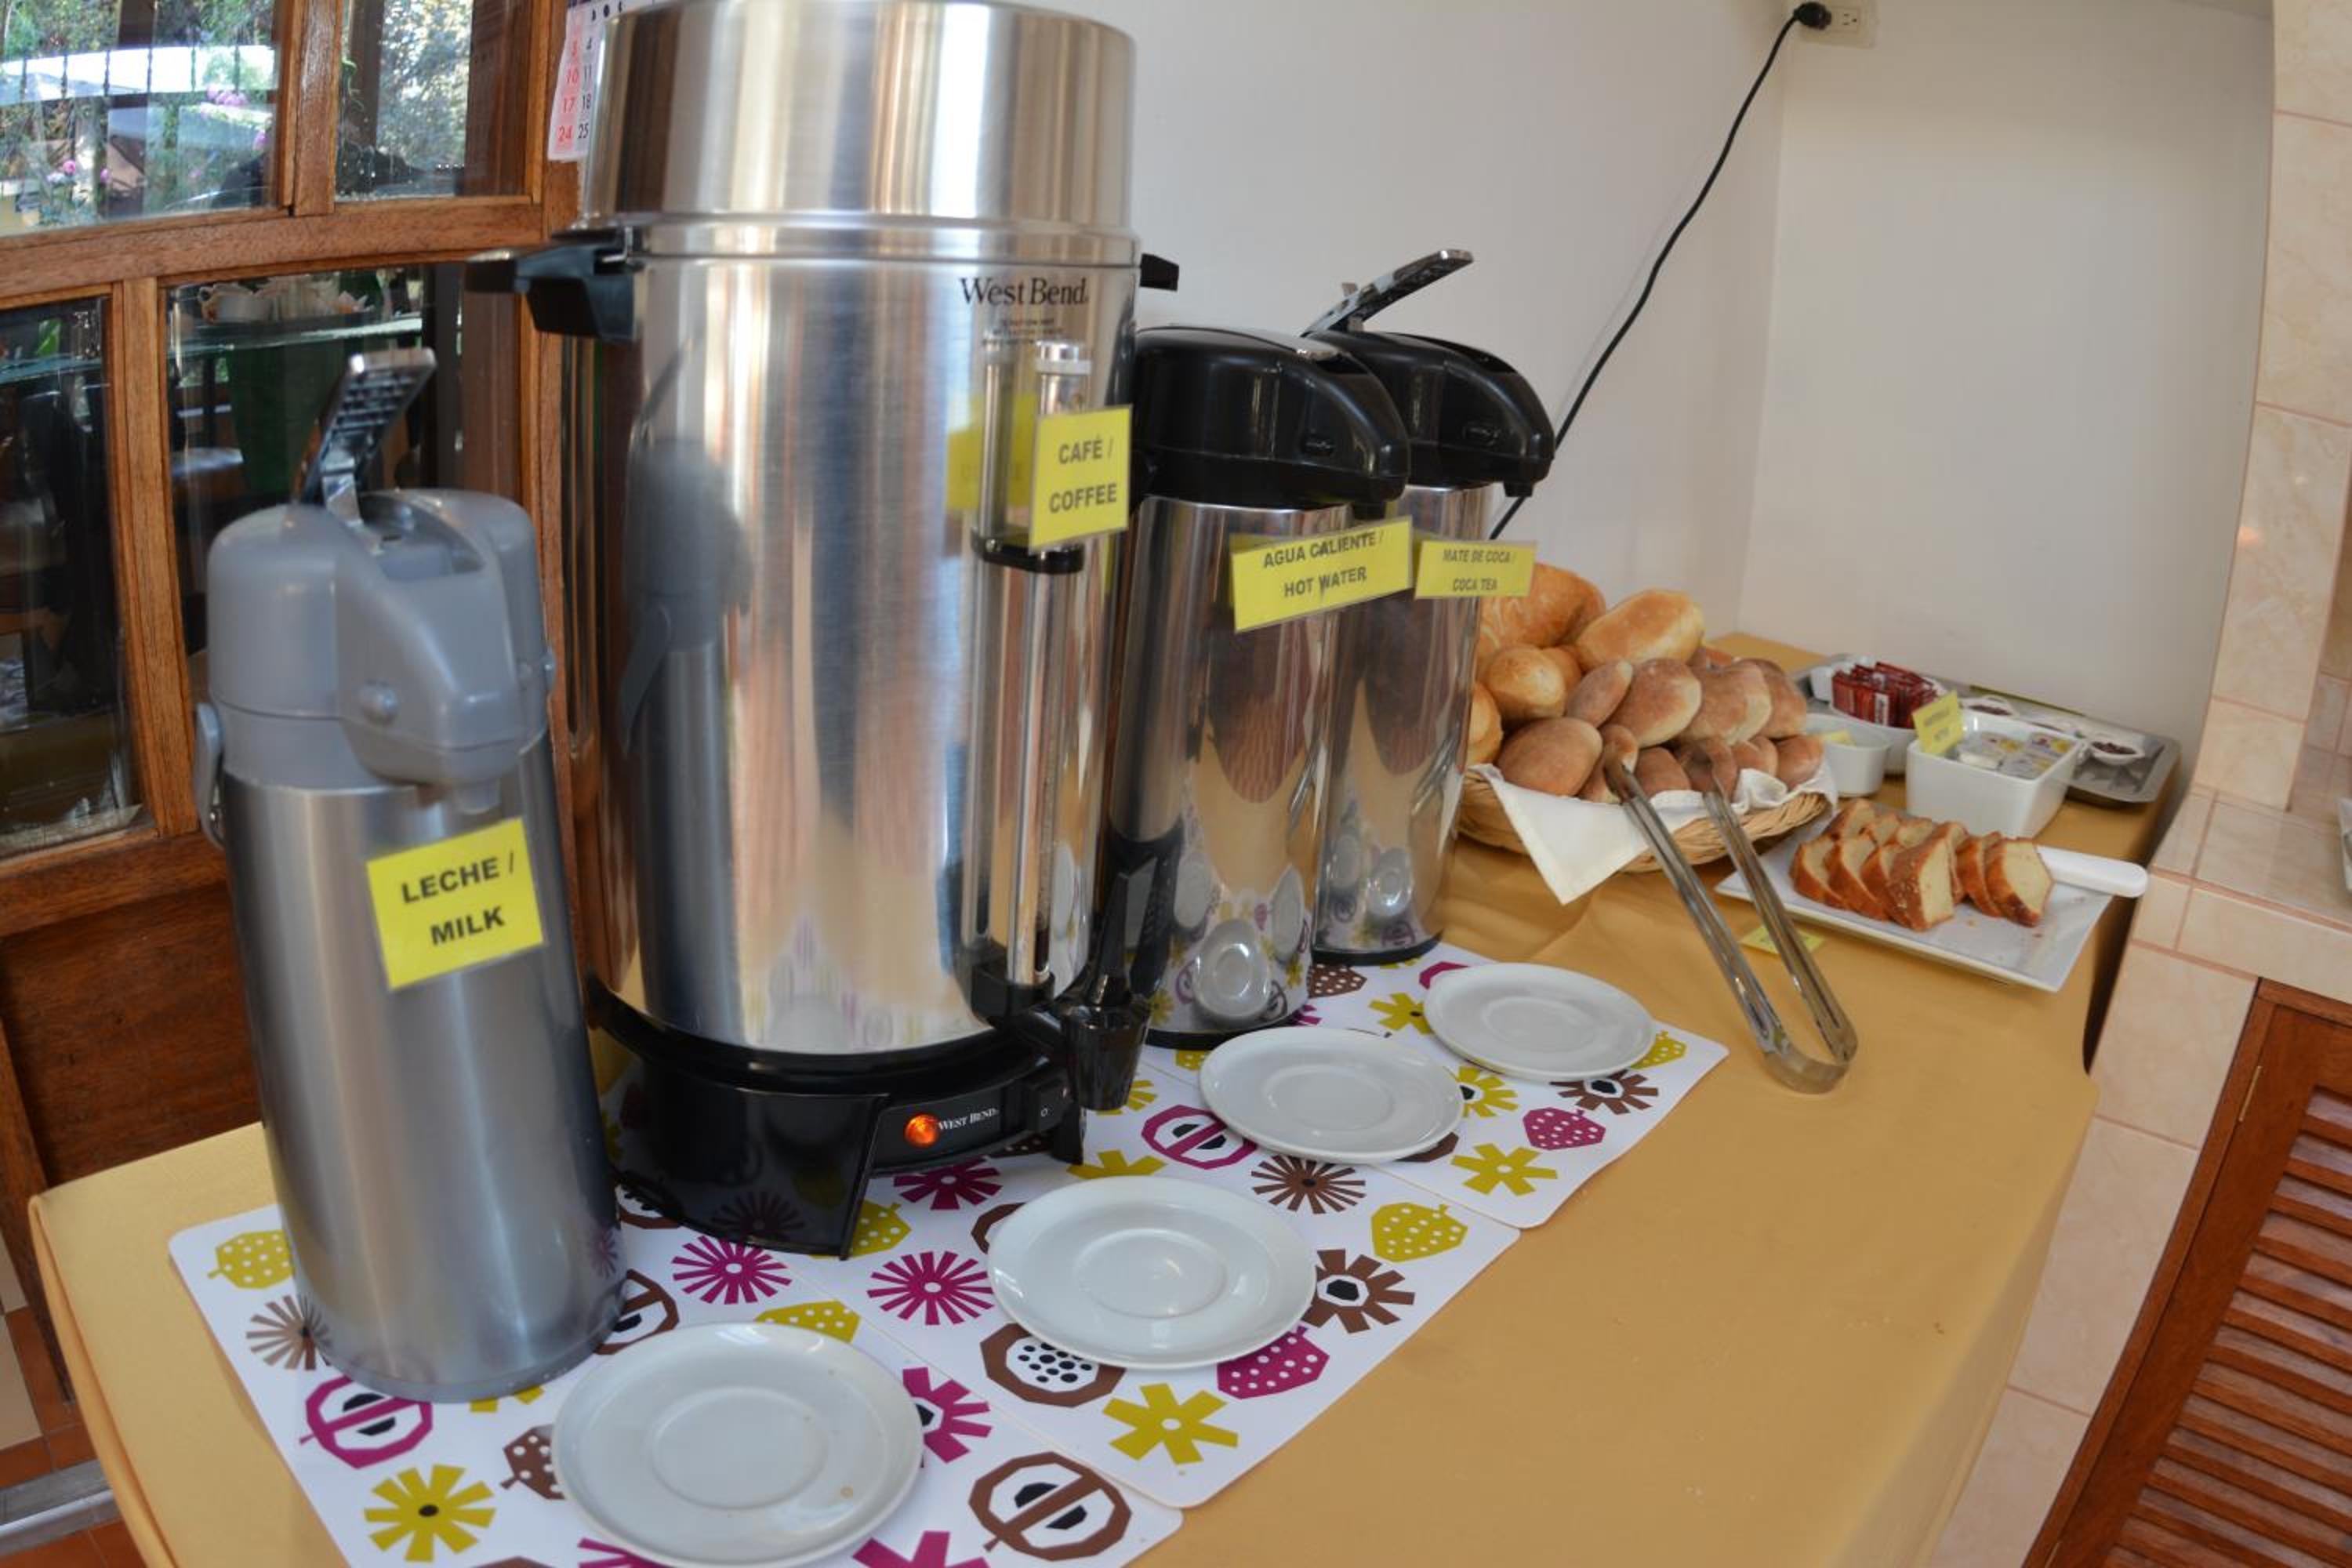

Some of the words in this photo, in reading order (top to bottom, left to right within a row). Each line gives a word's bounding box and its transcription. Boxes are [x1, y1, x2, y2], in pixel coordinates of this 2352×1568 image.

[567, 67, 579, 83] 10
[564, 97, 575, 111] 17
[583, 93, 592, 110] 18
[558, 125, 573, 142] 24
[578, 122, 590, 139] 25
[959, 277, 1025, 307] West
[1029, 277, 1087, 306] Bend
[1058, 434, 1102, 465] CAFÉ
[1049, 482, 1117, 514] COFFEE
[1263, 546, 1305, 568] AGUA
[1443, 550, 1470, 562] MATE
[1471, 550, 1484, 563] DE
[1486, 550, 1511, 564] COCA
[1284, 577, 1314, 597] HOT
[1318, 565, 1367, 592] WATER
[1452, 578, 1477, 592] COCA
[1480, 578, 1497, 591] TEA
[401, 857, 500, 904] LECHE
[430, 906, 506, 946] MILK
[938, 1116, 967, 1130] WEST
